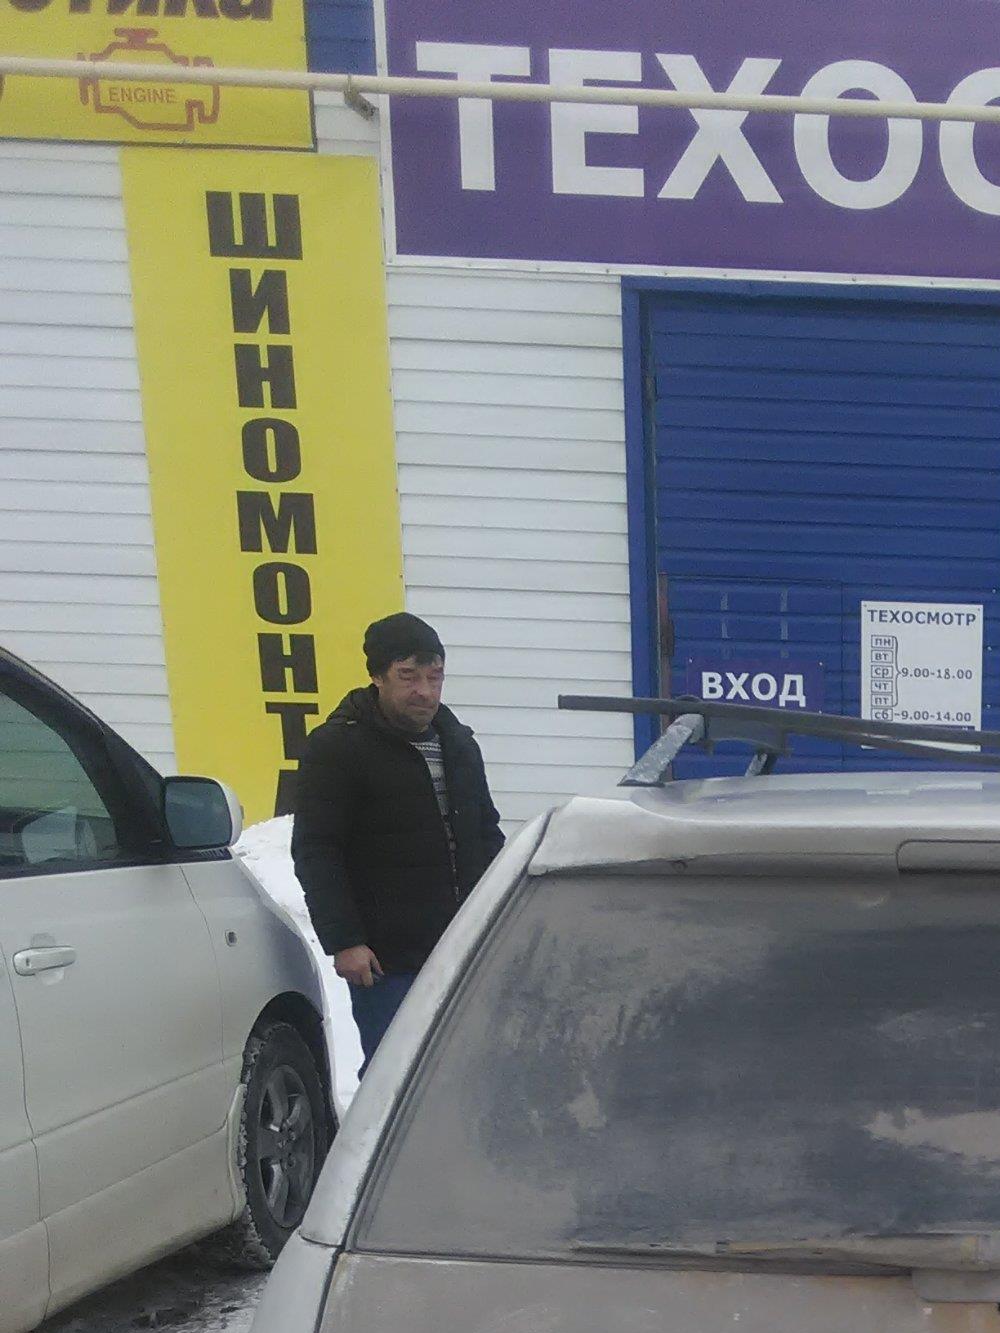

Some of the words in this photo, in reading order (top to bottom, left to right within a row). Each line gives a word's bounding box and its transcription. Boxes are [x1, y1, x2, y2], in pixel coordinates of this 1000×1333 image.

[108, 87, 178, 104] ENGINE
[867, 608, 977, 627] ТЕХОСМОТР
[901, 667, 973, 681] 9.00-18.00
[701, 671, 807, 708] ВХОД
